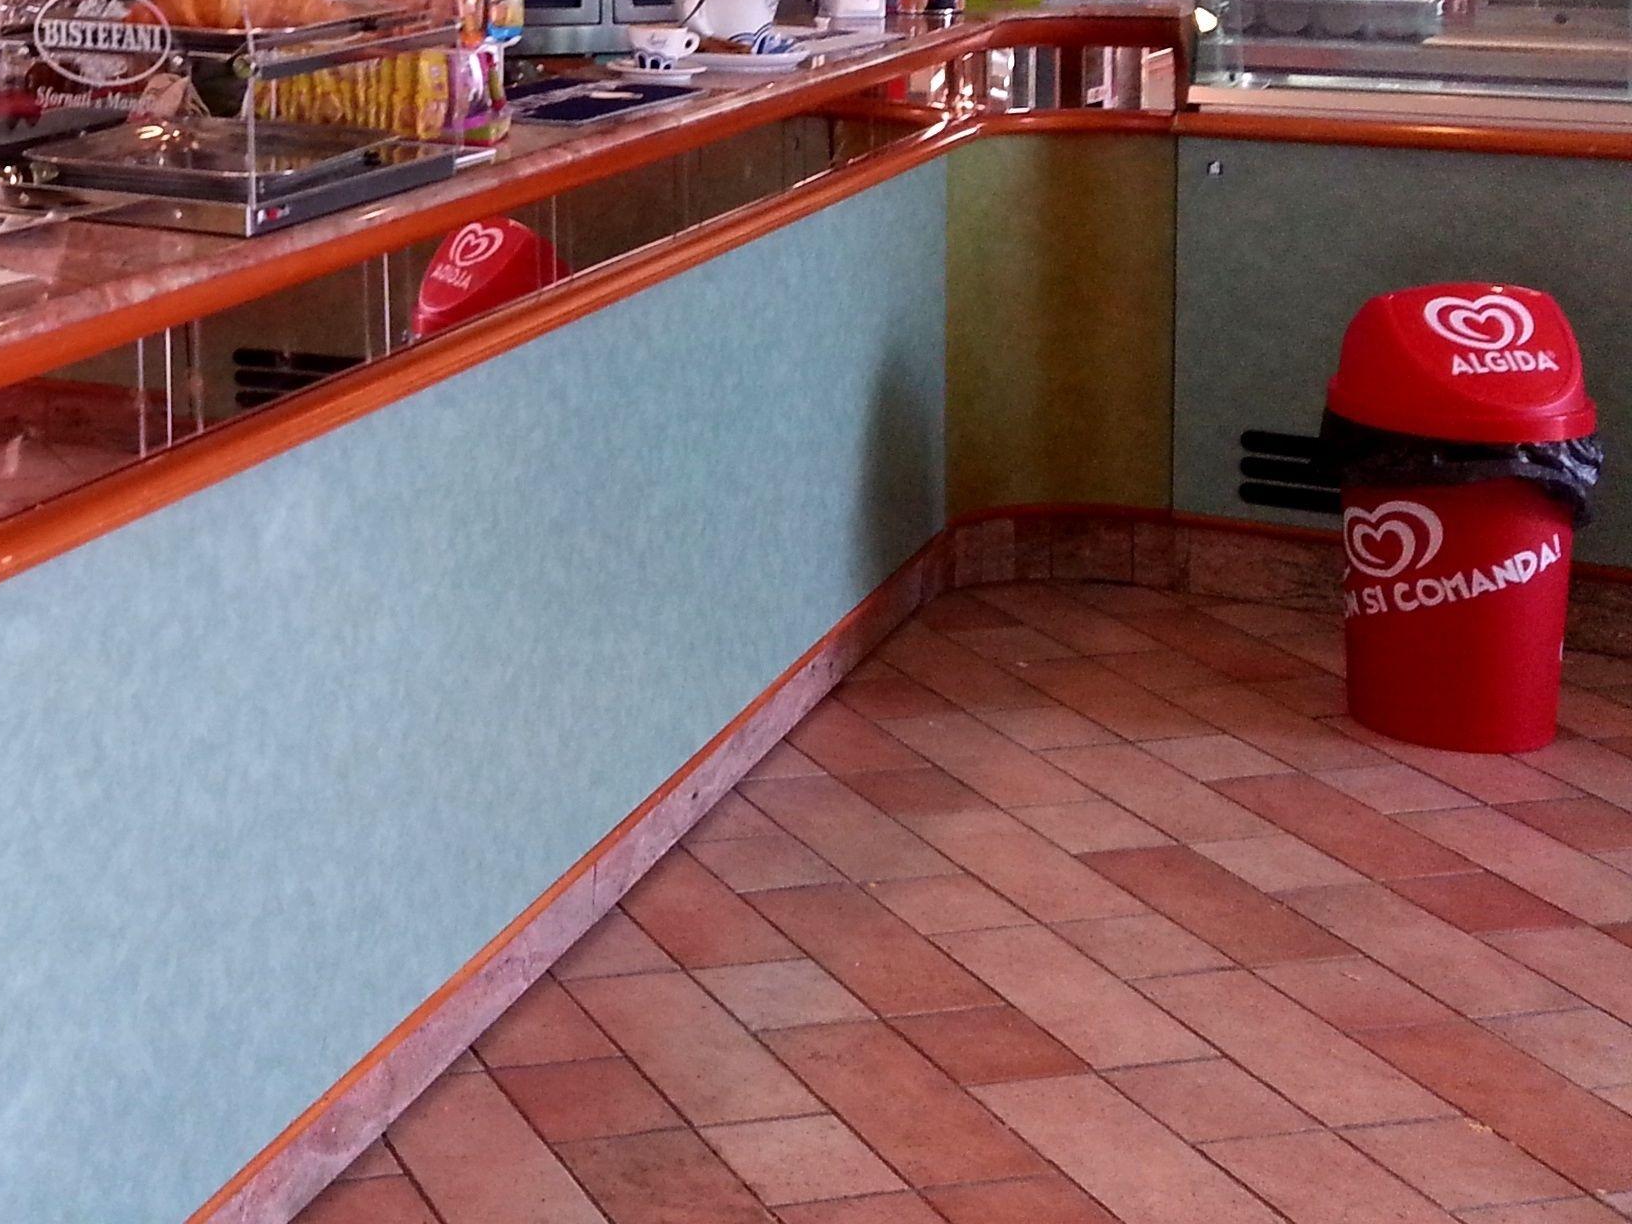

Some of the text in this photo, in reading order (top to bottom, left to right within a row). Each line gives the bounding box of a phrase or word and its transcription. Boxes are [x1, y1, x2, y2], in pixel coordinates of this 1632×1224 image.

[42, 19, 162, 52] BISTEFANI
[1452, 350, 1560, 376] ALGIDA
[1362, 585, 1388, 615] SI
[1393, 533, 1562, 612] COMANDA!
